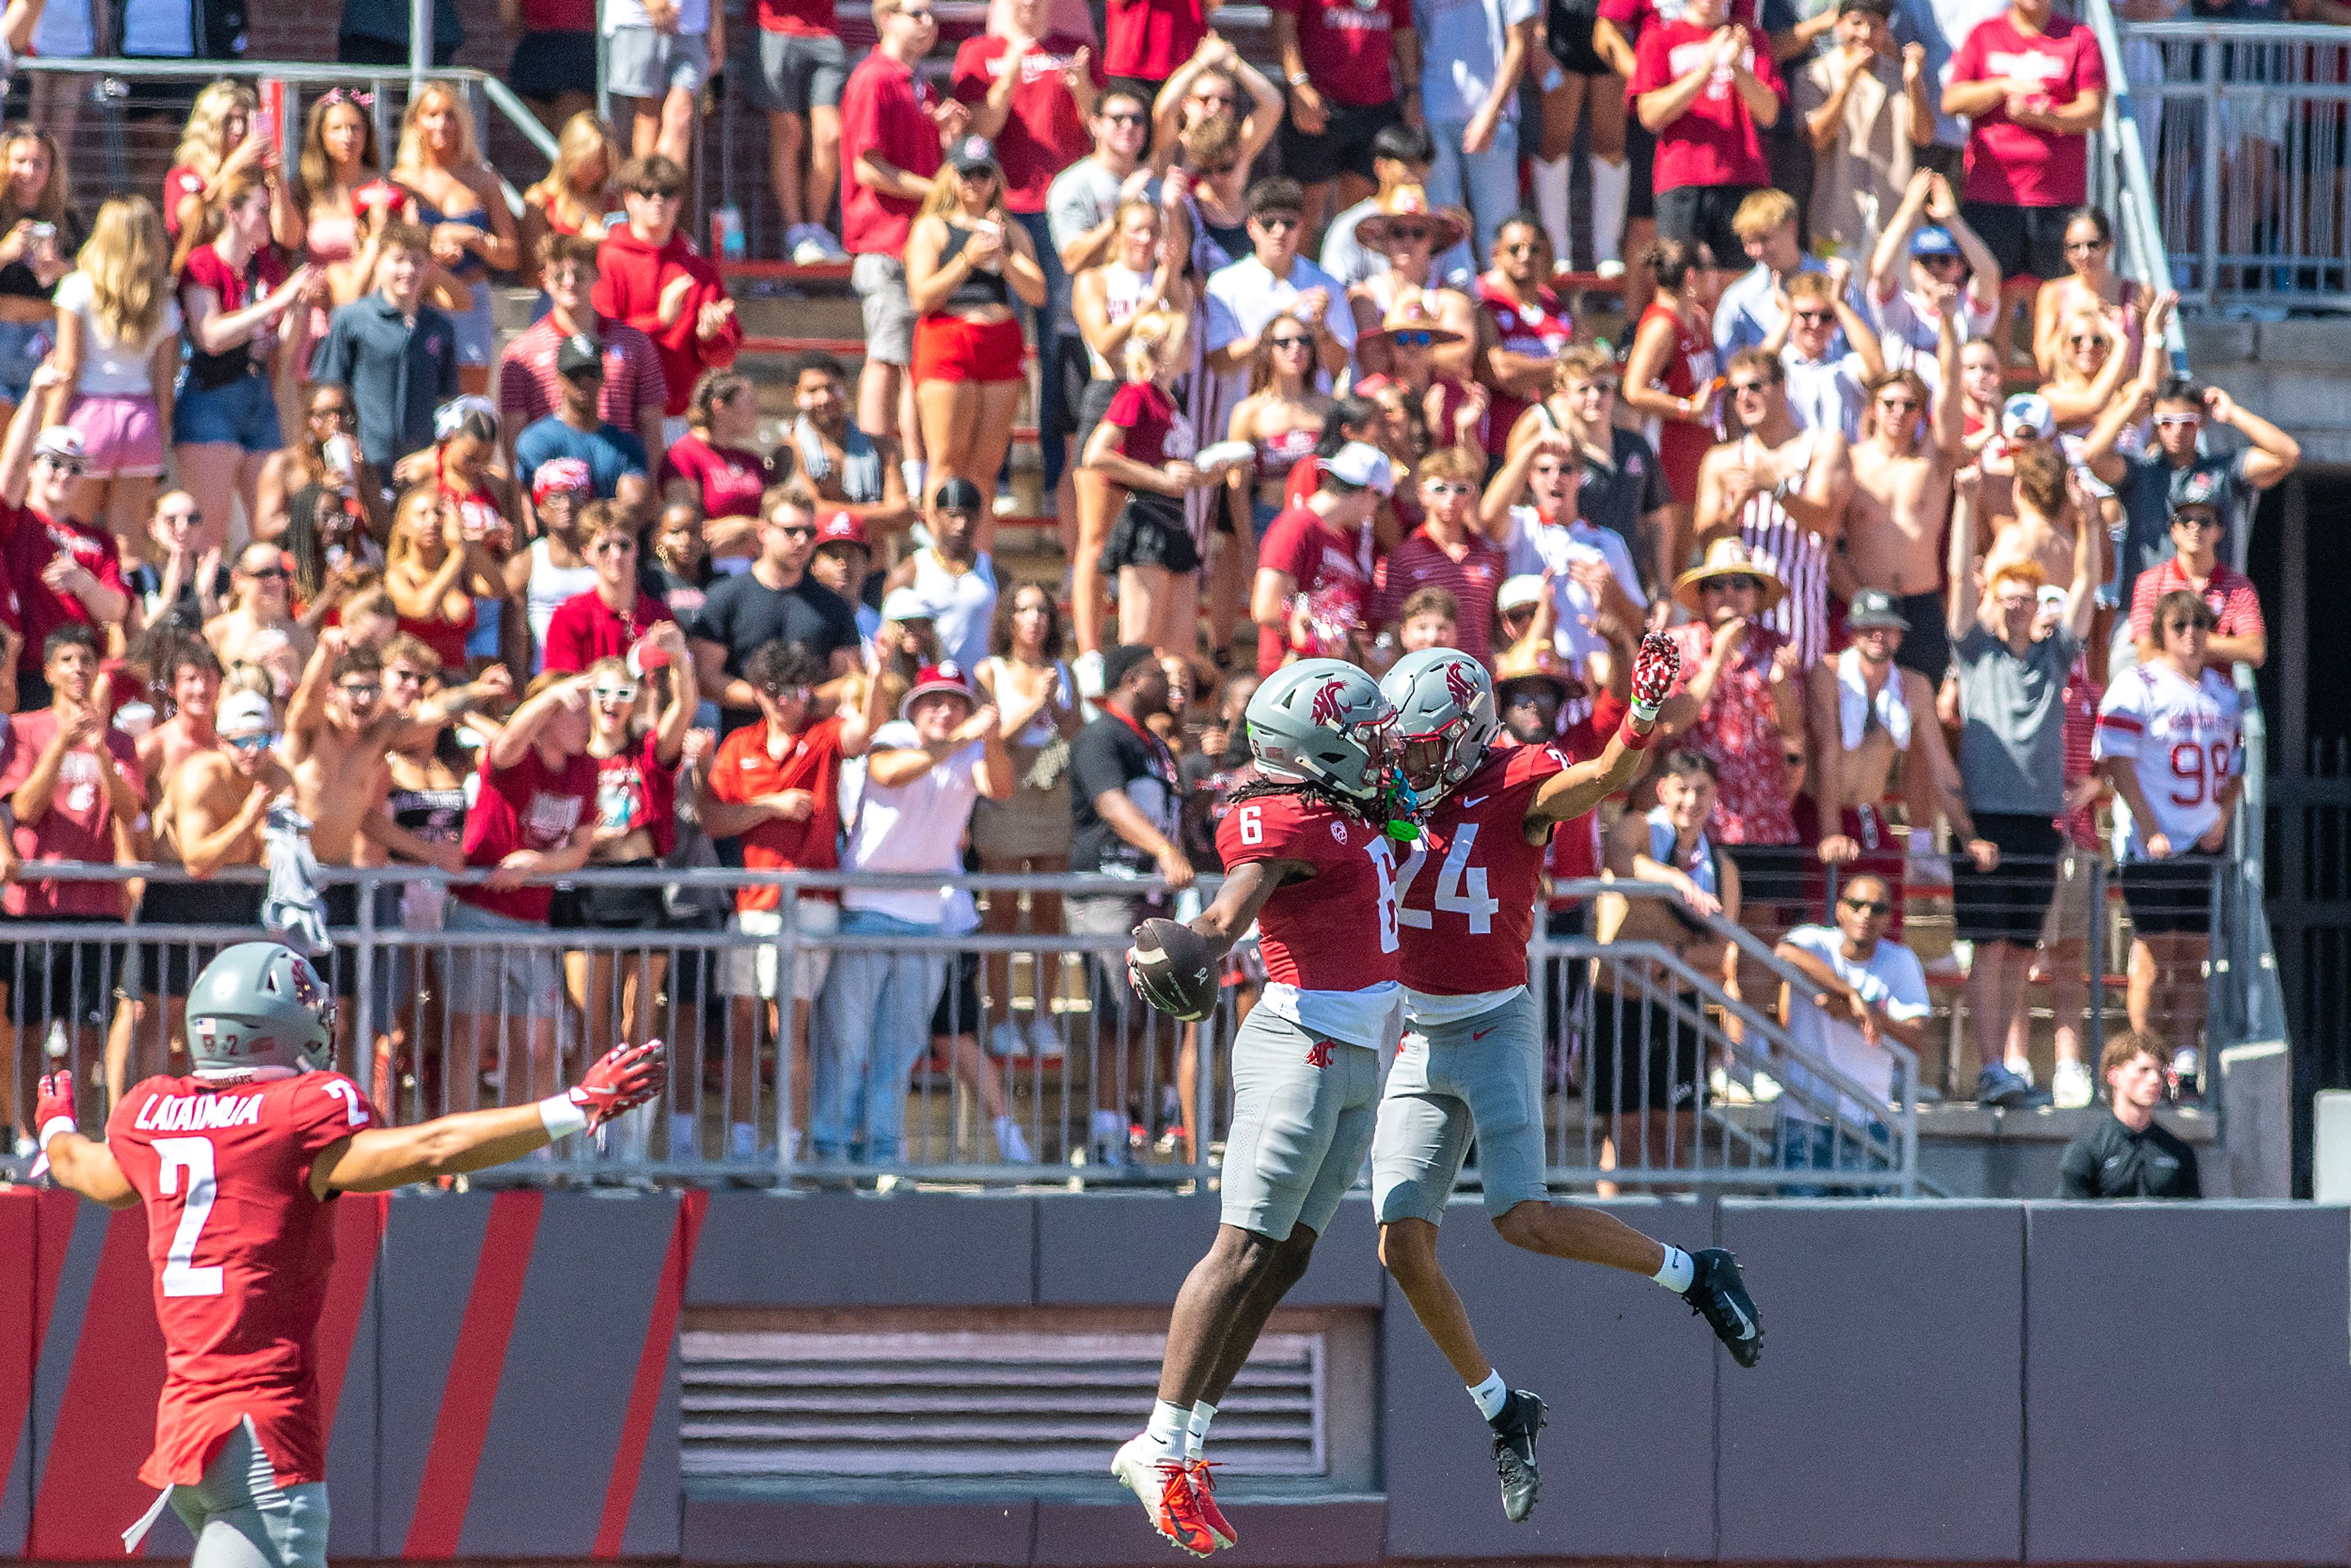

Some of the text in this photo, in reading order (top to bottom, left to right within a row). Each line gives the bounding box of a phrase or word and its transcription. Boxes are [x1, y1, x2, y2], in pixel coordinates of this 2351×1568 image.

[1240, 806, 1262, 846] 6
[1395, 823, 1499, 934] 24
[226, 1033, 239, 1057] 2
[135, 1093, 264, 1130] LATAIMUA
[320, 1079, 370, 1127] 2
[151, 1136, 224, 1297] 2
